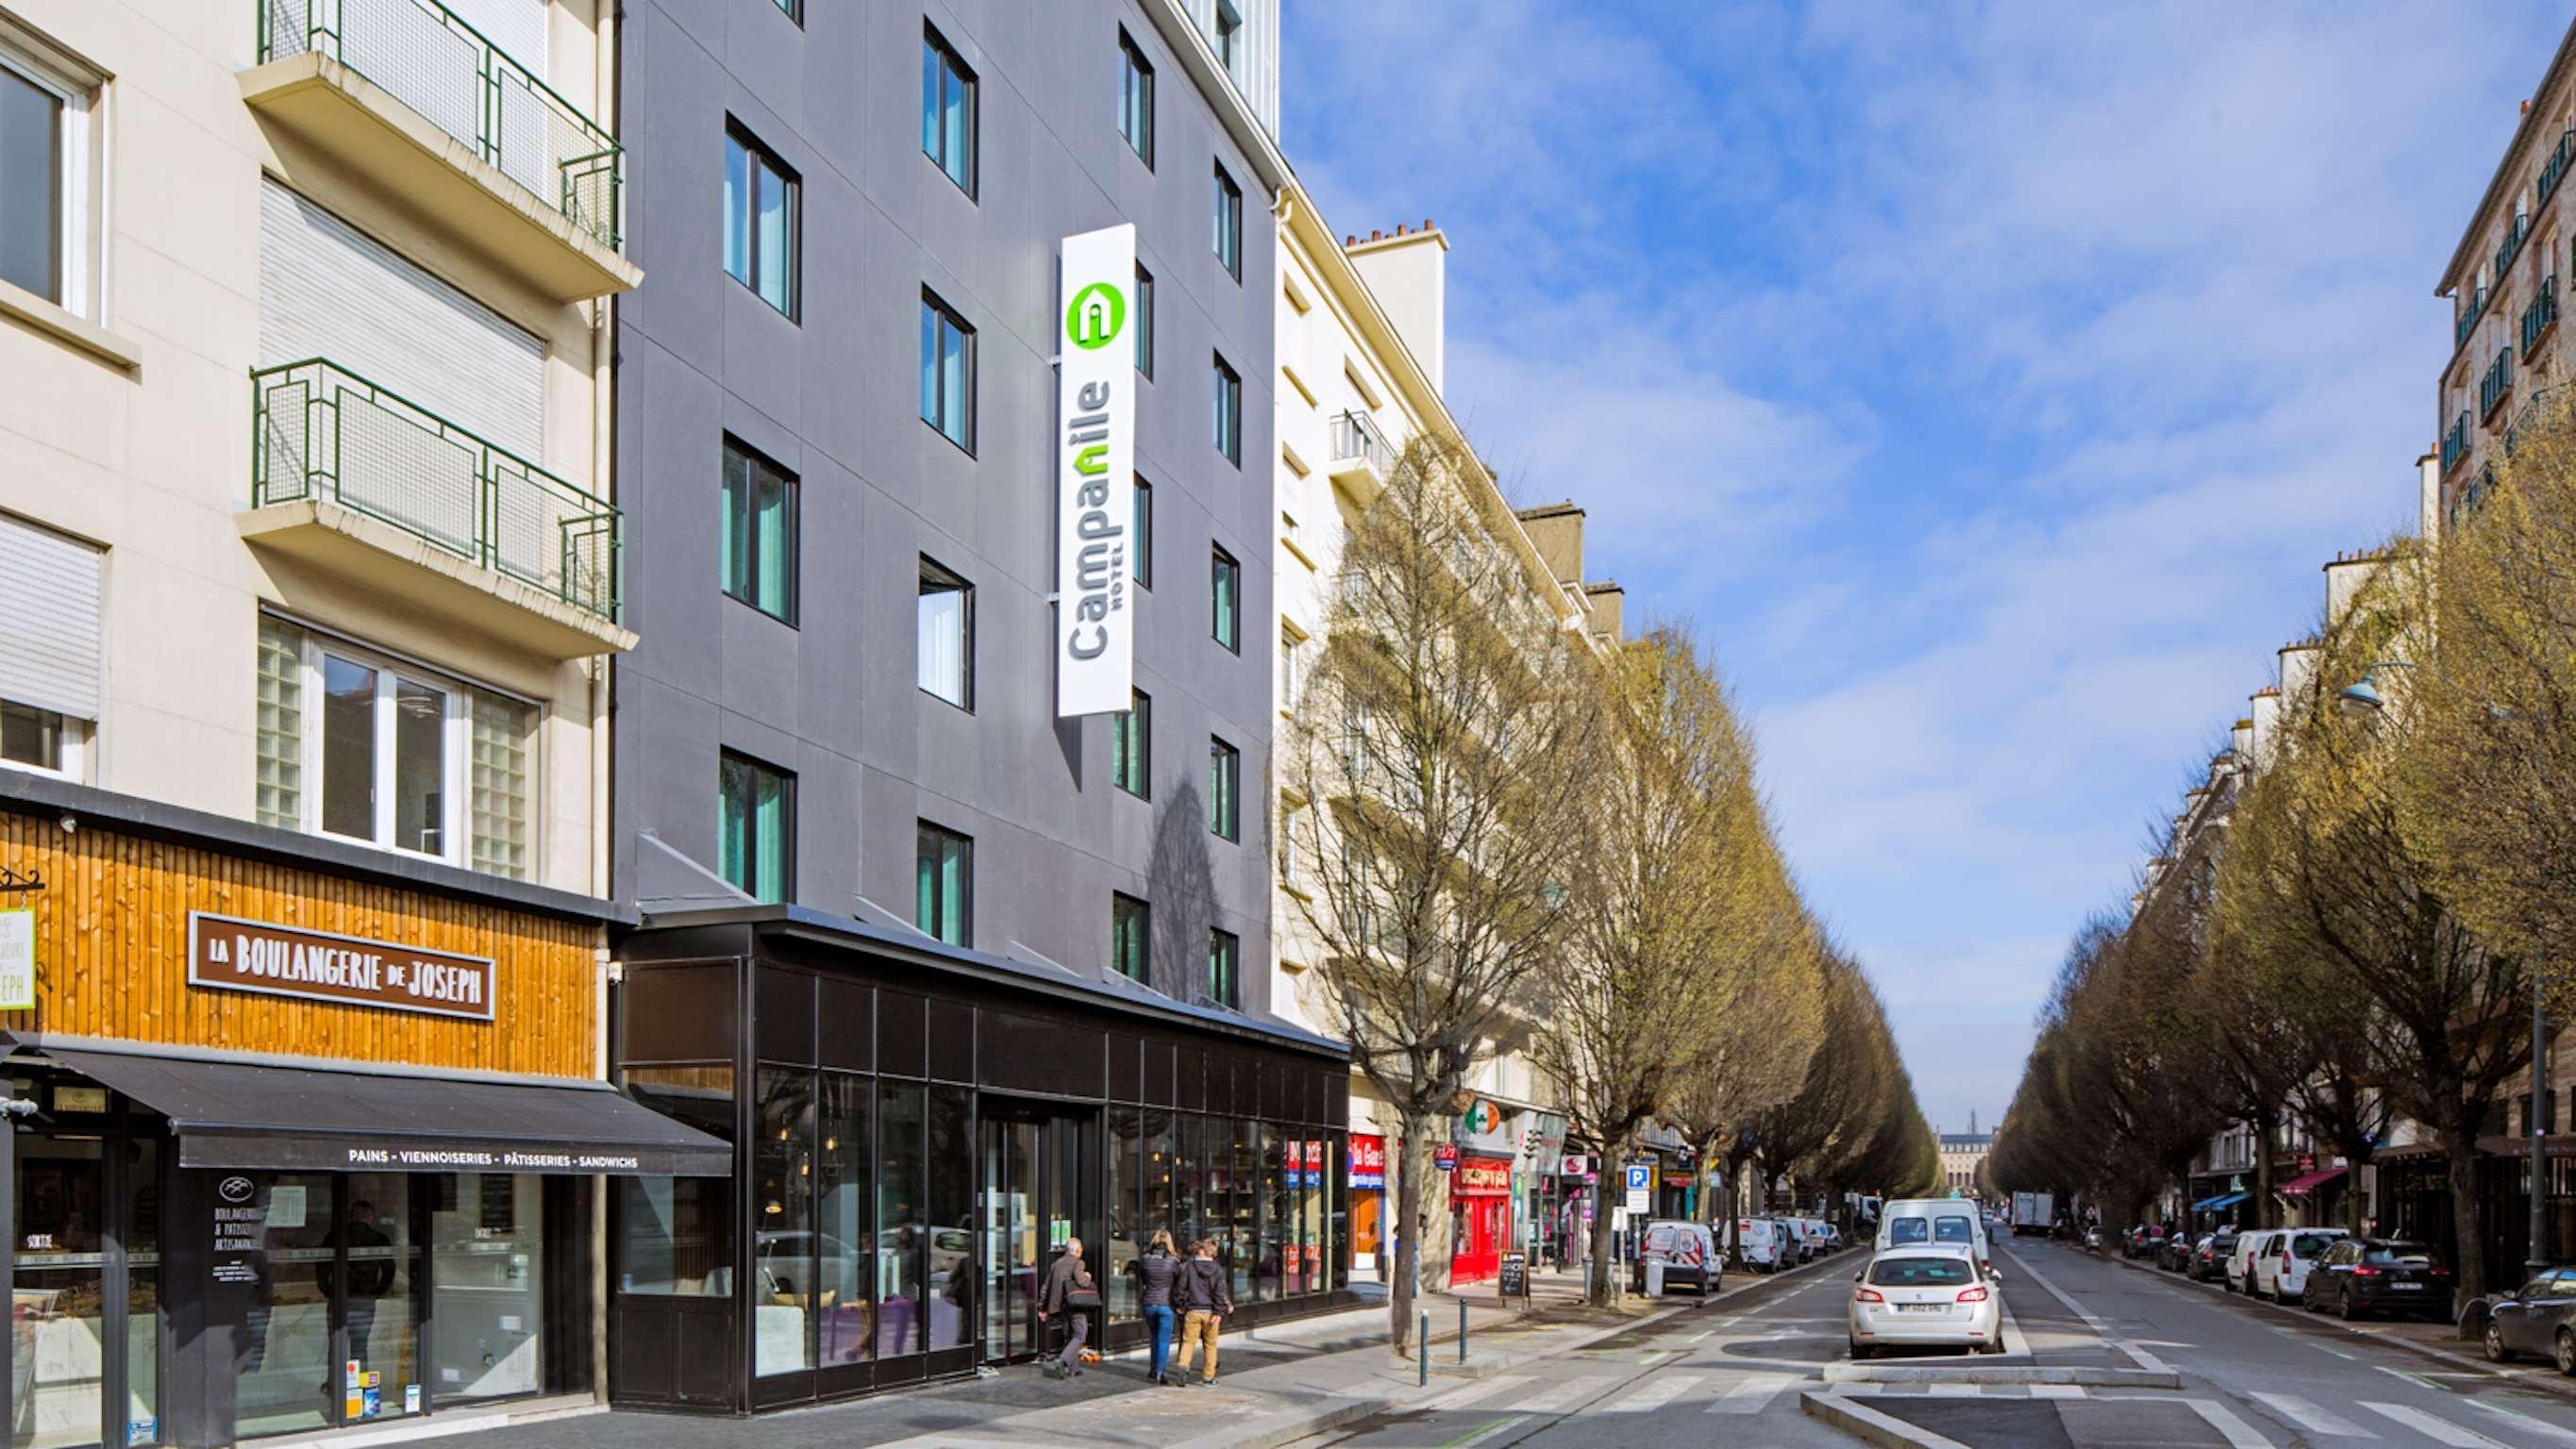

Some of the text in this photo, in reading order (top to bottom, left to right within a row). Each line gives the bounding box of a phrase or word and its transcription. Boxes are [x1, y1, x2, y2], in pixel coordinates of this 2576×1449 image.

[1068, 380, 1124, 661] Campanile
[1111, 541, 1124, 611] HOTEL
[209, 935, 482, 1005] LA BOULANGERIE DE JOSEPH
[349, 1149, 388, 1163] PAINS
[399, 1151, 493, 1165] VIENNOISERIES
[503, 1151, 571, 1167] PÂTISSERIES
[578, 1156, 638, 1169] SANDWICHS
[1632, 1171, 1644, 1186] P
